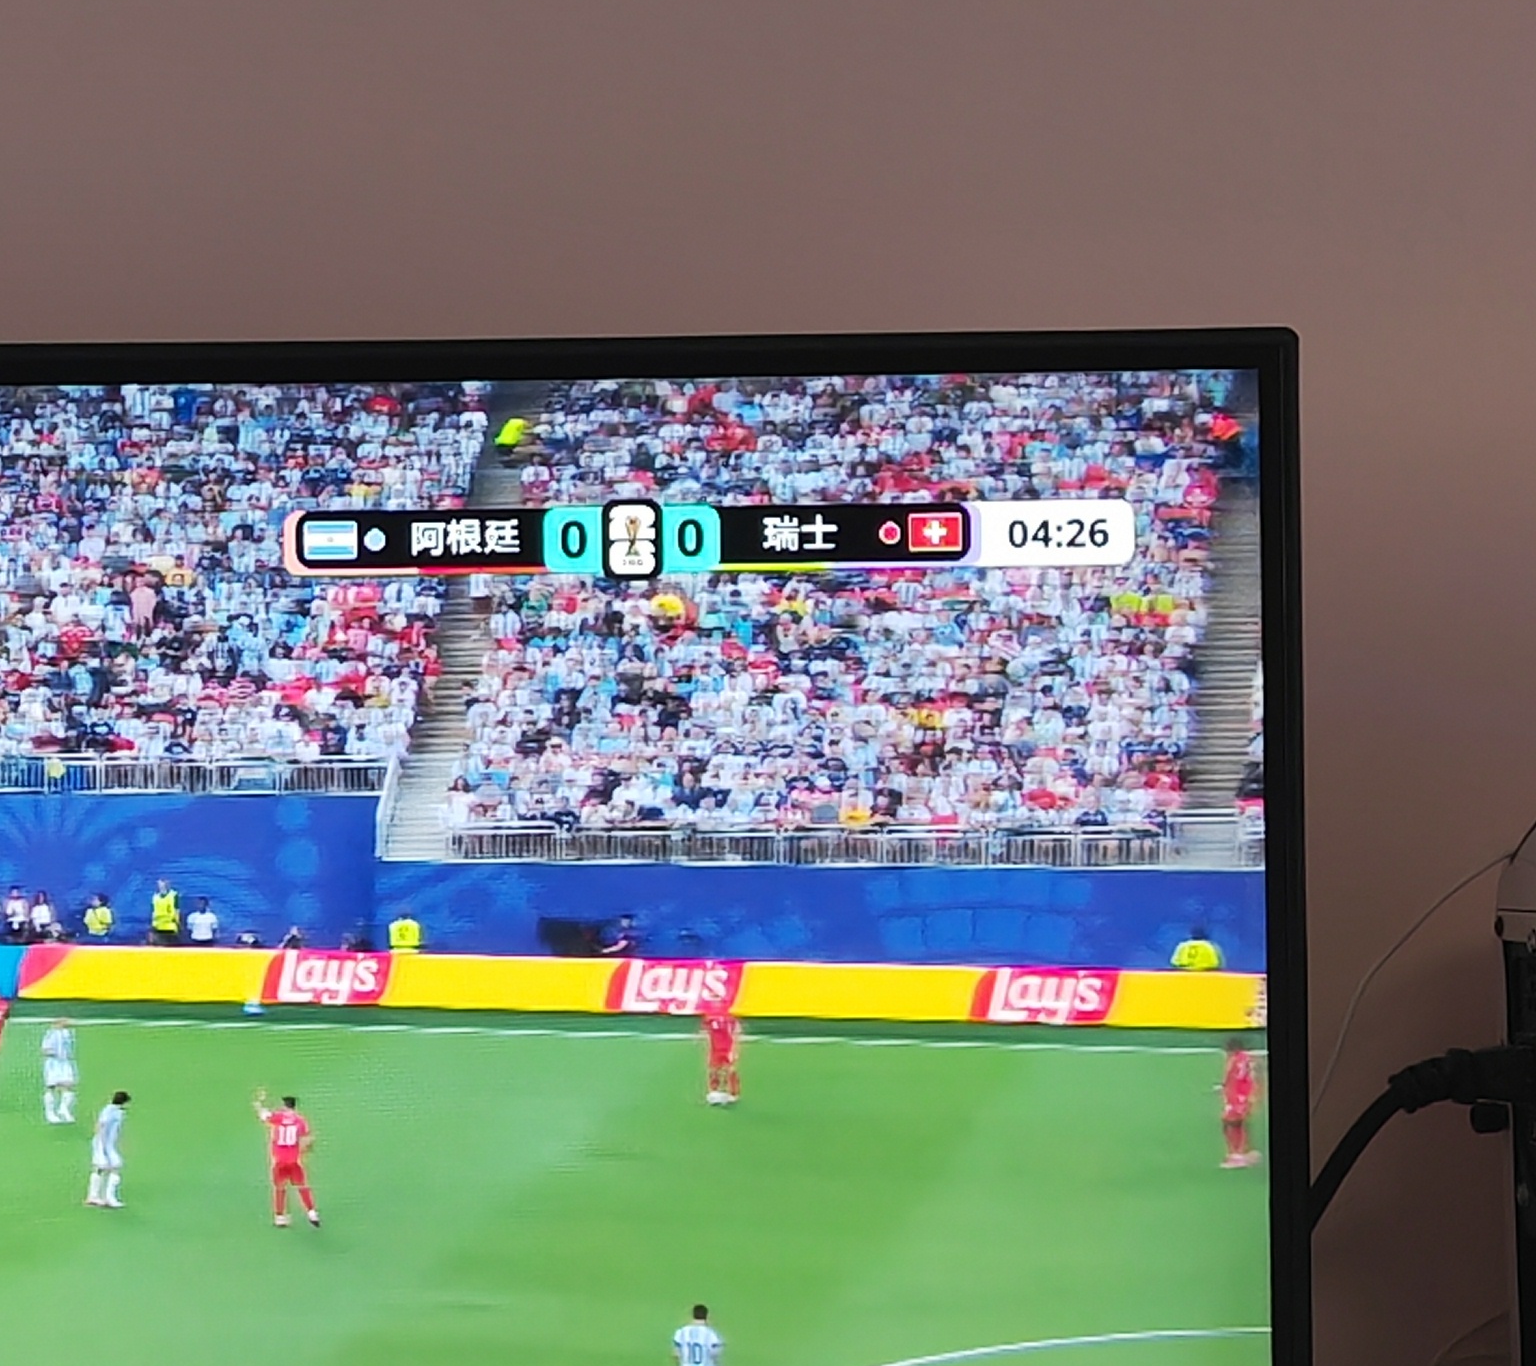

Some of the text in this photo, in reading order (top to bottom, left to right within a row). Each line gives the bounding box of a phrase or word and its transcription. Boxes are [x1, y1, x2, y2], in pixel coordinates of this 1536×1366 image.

[411, 514, 1109, 557] 阿根廷 0 0 瑞士 04:26
[277, 949, 378, 1004] Lay's
[621, 960, 728, 1014] Lay's
[987, 967, 1104, 1025] Lay's
